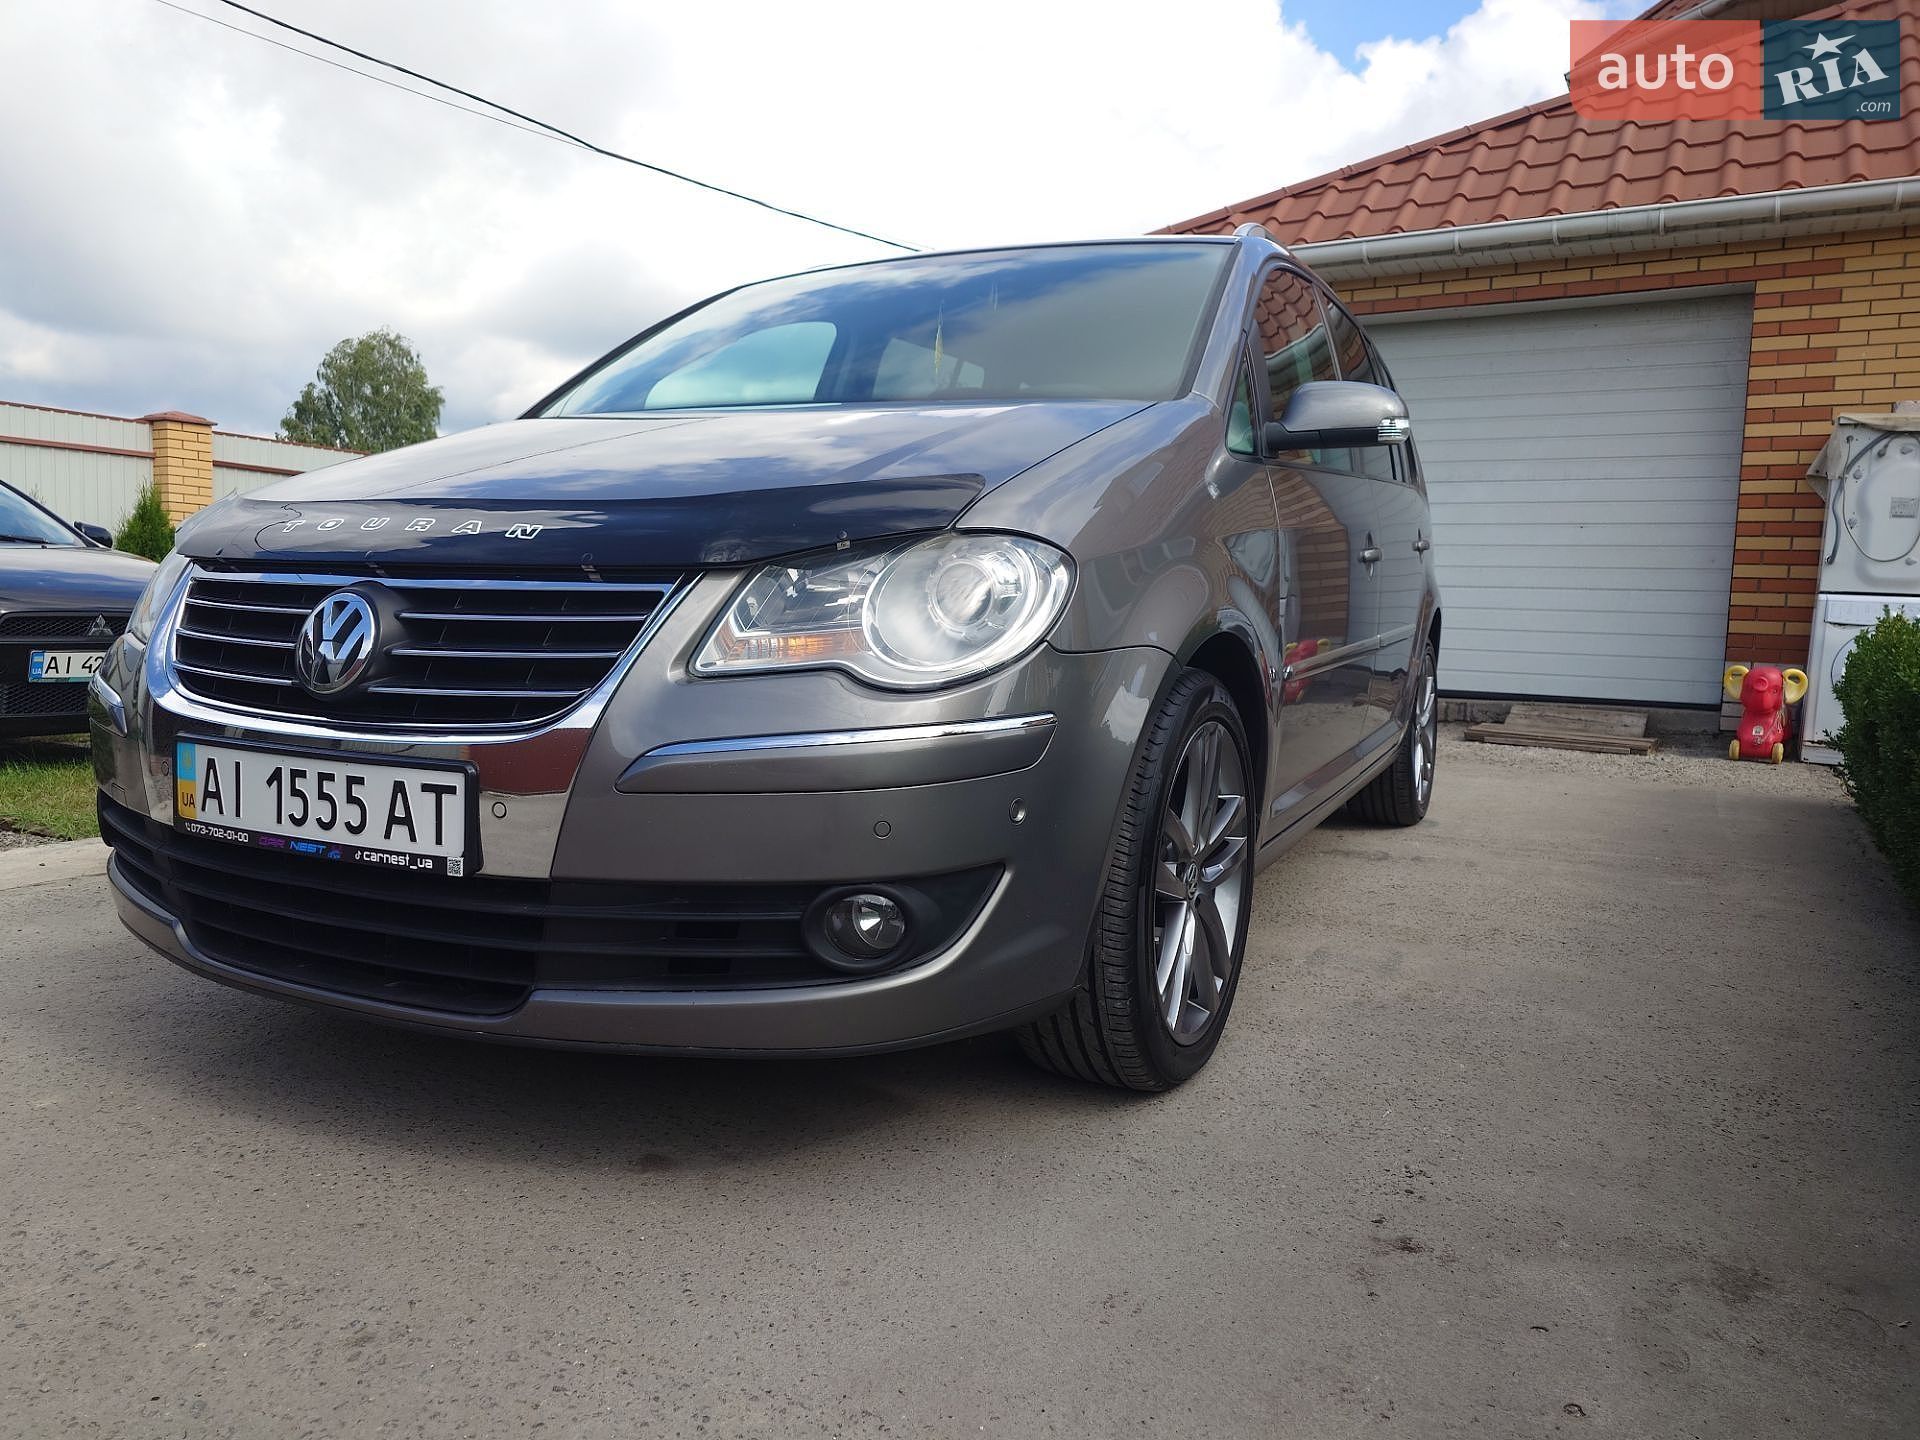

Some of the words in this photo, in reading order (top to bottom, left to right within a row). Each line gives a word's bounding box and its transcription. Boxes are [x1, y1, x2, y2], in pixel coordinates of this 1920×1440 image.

[282, 517, 543, 539] TOURAN
[44, 656, 72, 674] AI
[181, 792, 196, 808] UA
[201, 757, 241, 818] AI
[265, 766, 368, 835] 1555
[383, 780, 457, 846] AT
[191, 823, 249, 843] 073-702-01-00
[289, 840, 327, 854] NEST
[363, 851, 433, 870] carnest_ua
